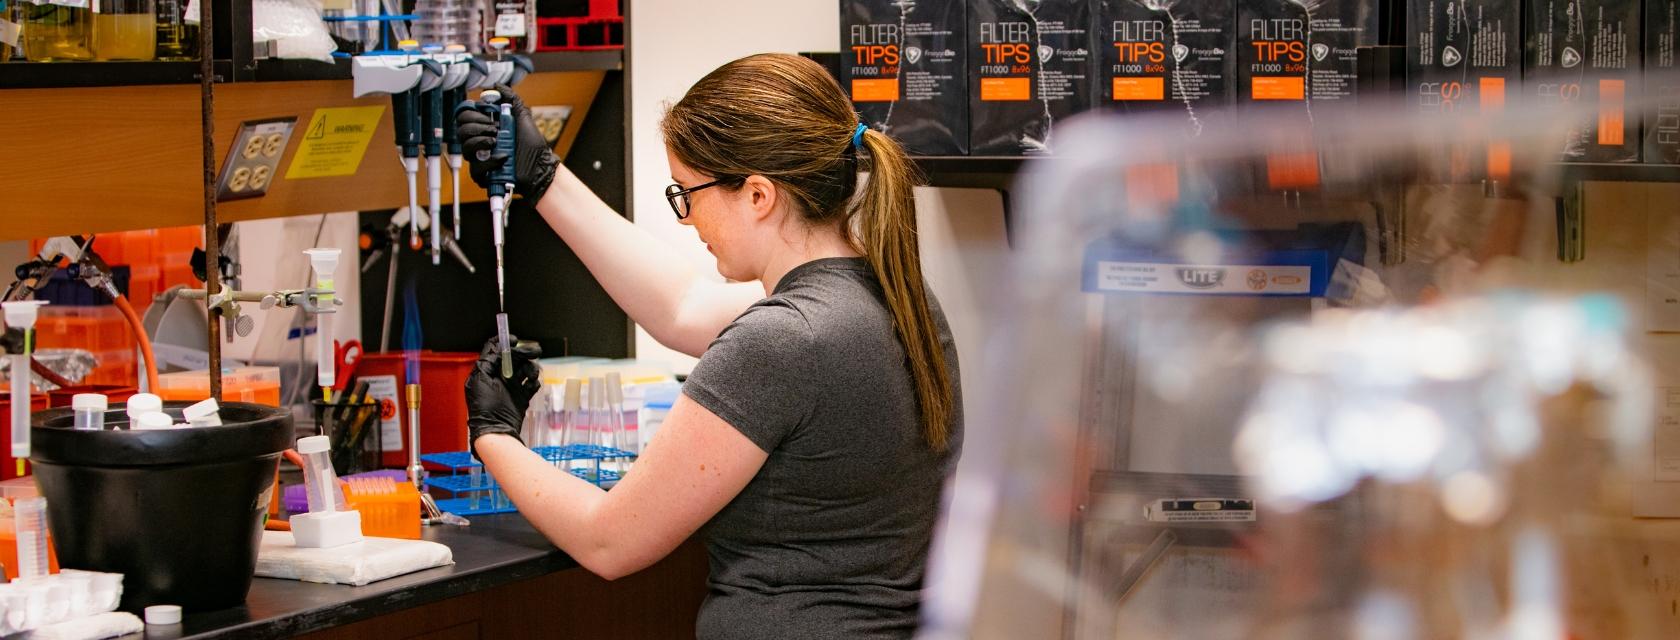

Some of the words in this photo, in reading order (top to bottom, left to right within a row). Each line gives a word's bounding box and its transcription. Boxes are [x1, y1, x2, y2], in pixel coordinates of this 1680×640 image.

[851, 23, 898, 44] FILTER
[980, 21, 1030, 43] FILTER
[1113, 20, 1165, 42] FILTER
[1251, 19, 1304, 41] FILTER
[851, 44, 899, 65] TIPS
[981, 43, 1030, 64] TIPS
[1114, 42, 1165, 63] TIPS
[1252, 41, 1305, 62] TIPS
[852, 66, 878, 75] FT1000
[980, 65, 1009, 74] FT1000
[1011, 65, 1031, 74] 8x96
[1113, 64, 1142, 73] FT1000
[1145, 64, 1165, 73] 8x96
[1251, 64, 1281, 73] FT1000
[1285, 64, 1305, 73] 8x96
[1183, 270, 1217, 283] LITE
